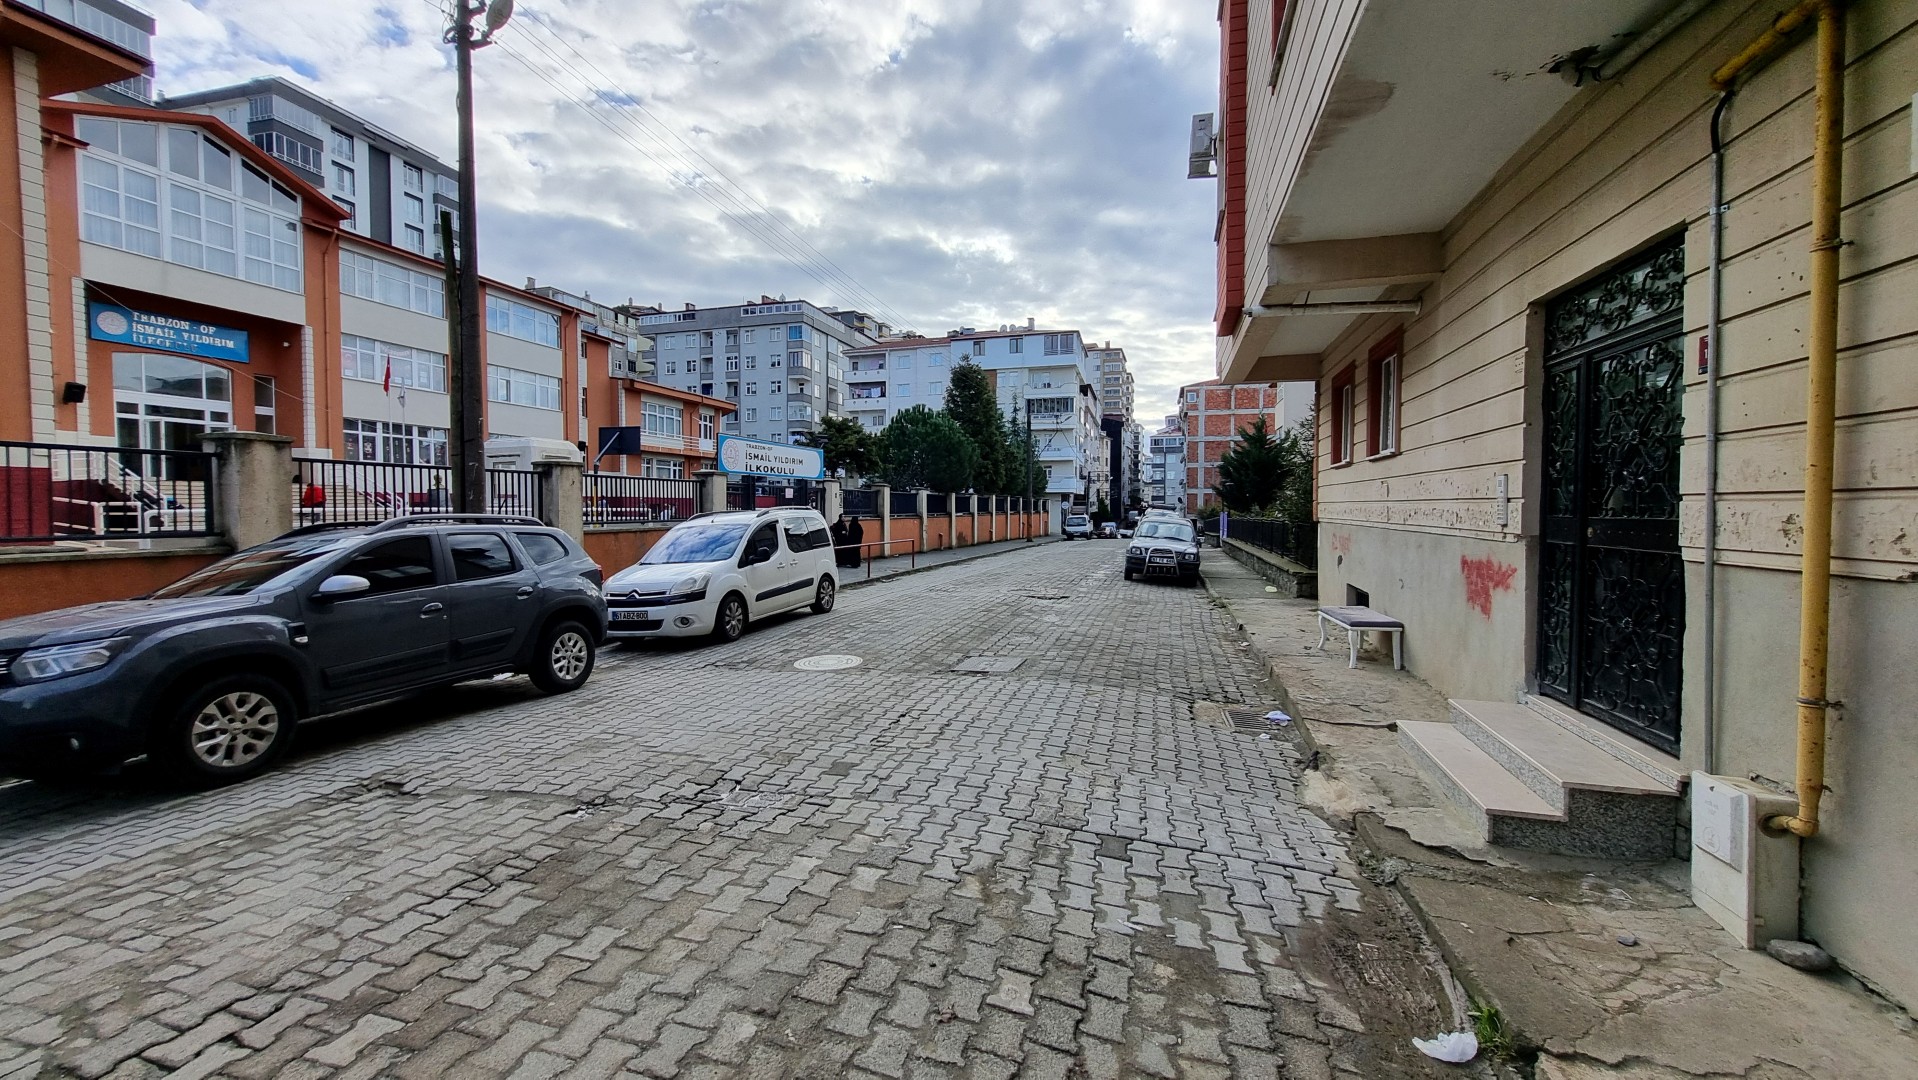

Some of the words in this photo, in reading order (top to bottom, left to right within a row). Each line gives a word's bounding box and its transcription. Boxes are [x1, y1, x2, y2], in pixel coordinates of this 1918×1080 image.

[132, 311, 190, 331] TRABZON
[200, 325, 216, 335] OF
[132, 321, 177, 339] İSMAİL
[182, 331, 236, 349] YILDIRIM
[745, 461, 795, 475] İLKOKULU
[746, 450, 772, 462] İSMAİL
[773, 455, 804, 466] YILDIRIM
